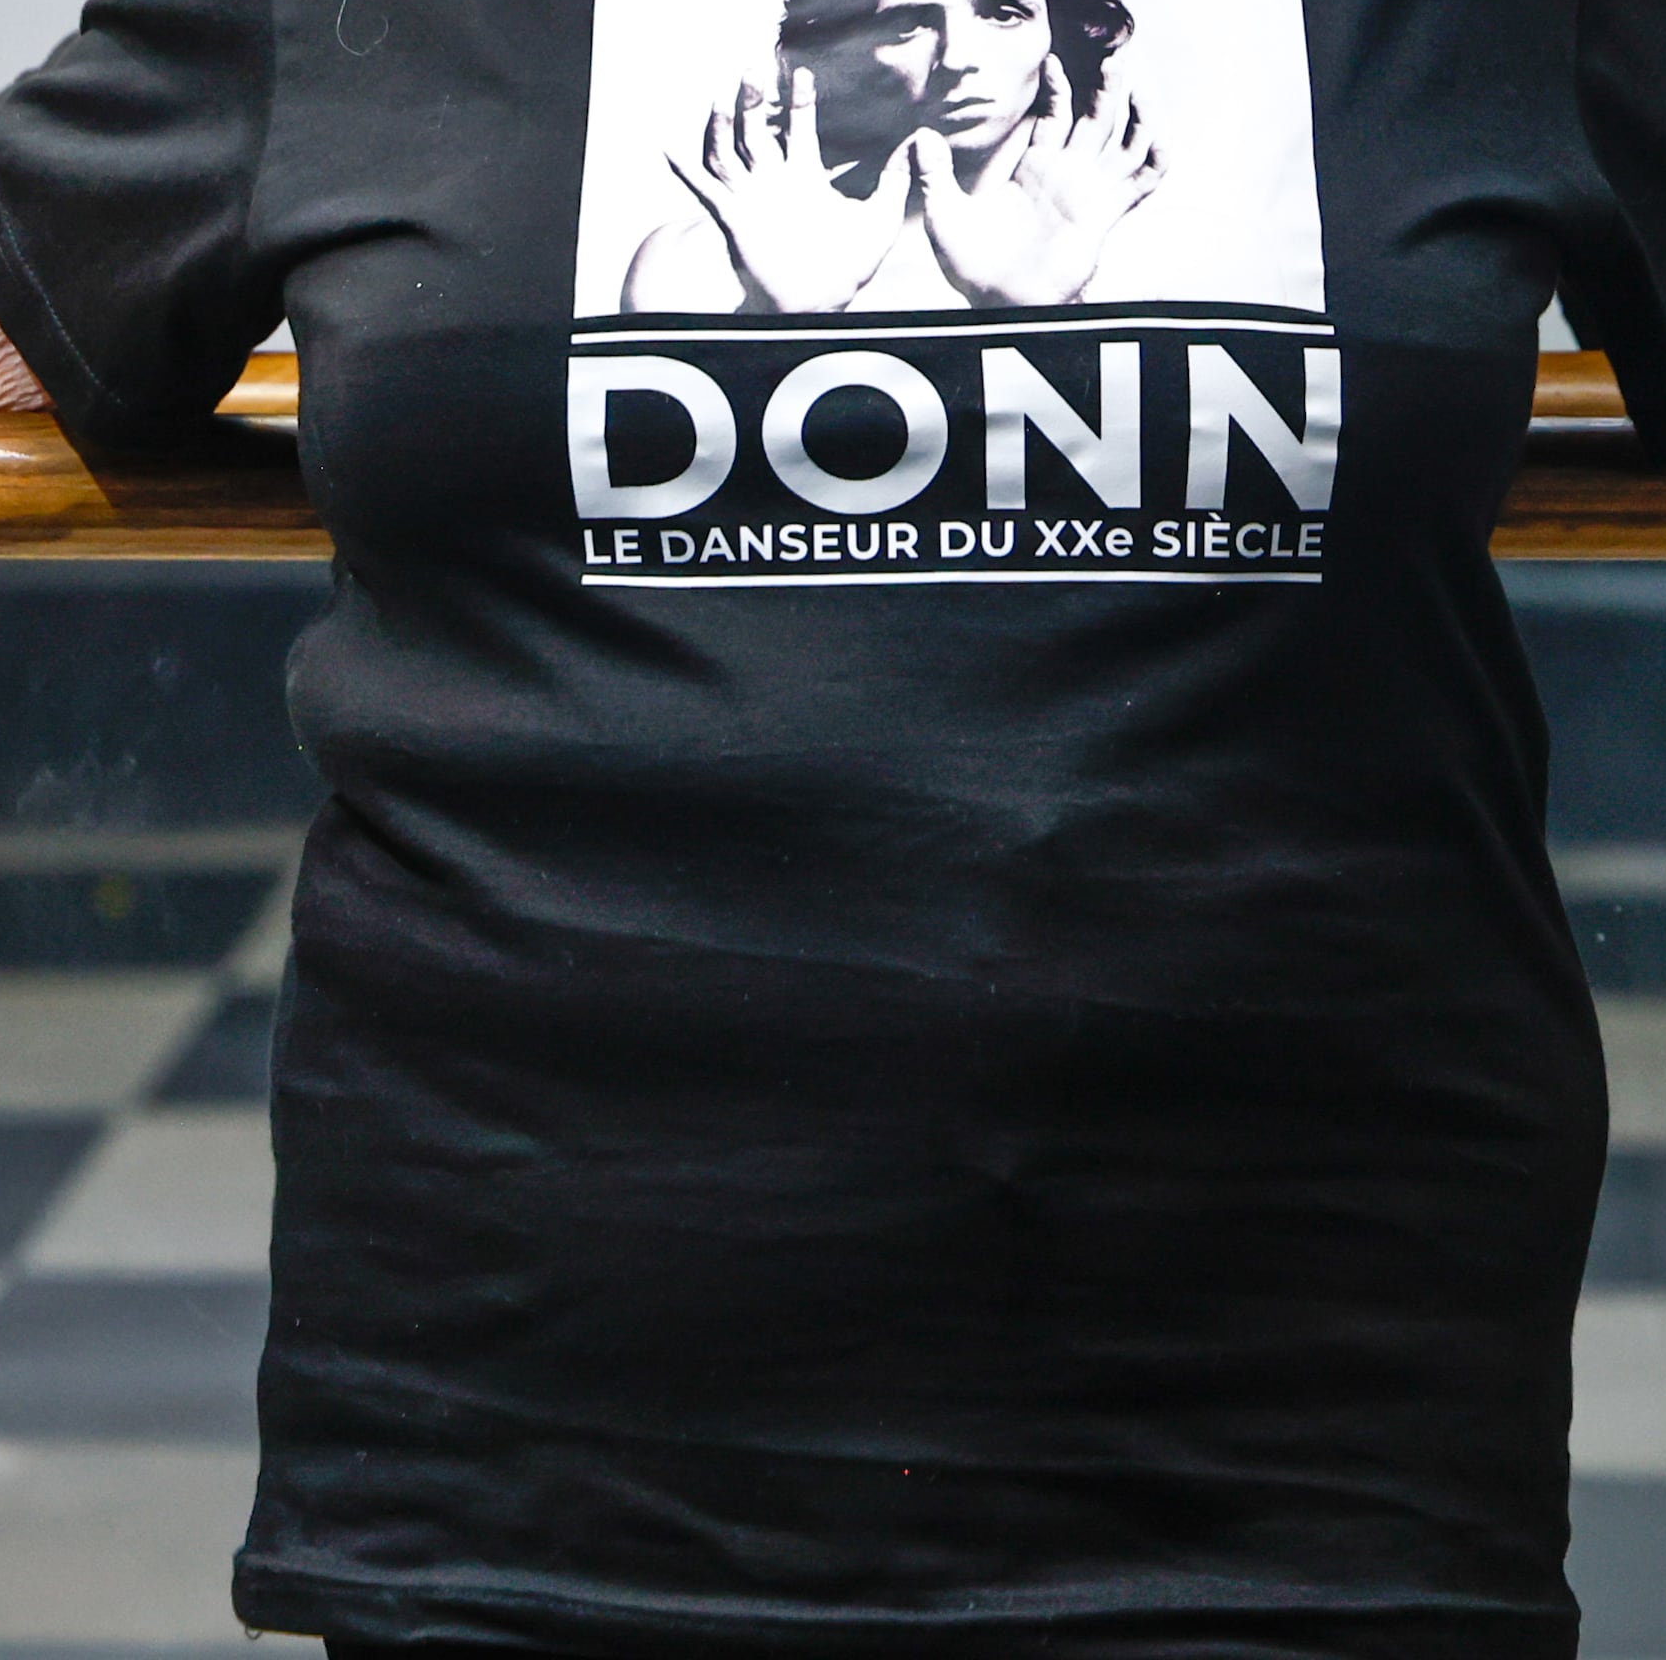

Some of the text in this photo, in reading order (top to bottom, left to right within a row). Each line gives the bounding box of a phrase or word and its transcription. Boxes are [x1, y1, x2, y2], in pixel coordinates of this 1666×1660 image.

[567, 342, 1342, 519] DONN
[584, 512, 1324, 565] LE DANSEUR DU XXe SIÈCLE
